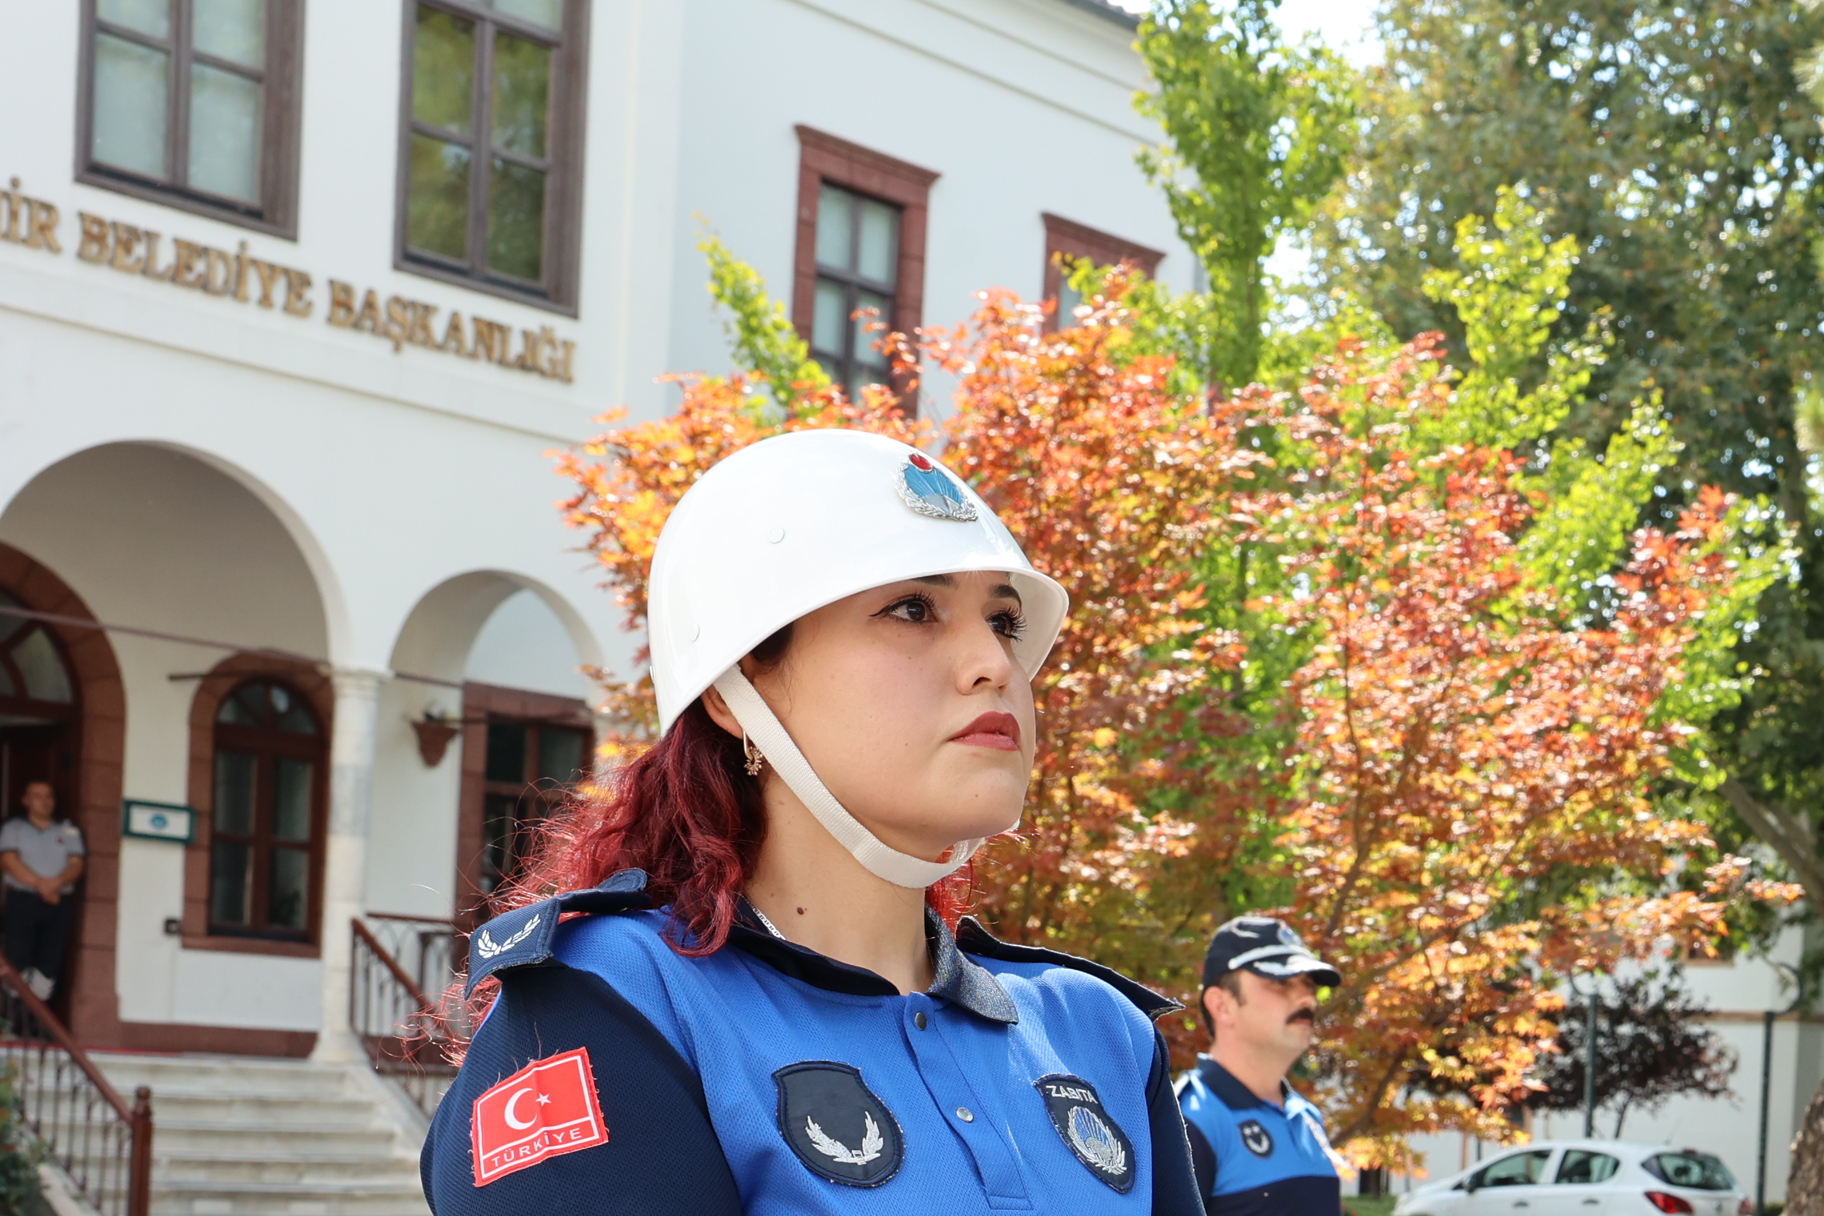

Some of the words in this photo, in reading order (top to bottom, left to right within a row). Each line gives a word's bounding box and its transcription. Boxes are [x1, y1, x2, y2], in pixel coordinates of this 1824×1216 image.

[76, 209, 314, 318] BELEDİYE
[327, 278, 576, 384] BAŞKANLIĞI
[1045, 1085, 1099, 1105] ZABITA
[491, 1127, 583, 1168] TÜRKİYE
